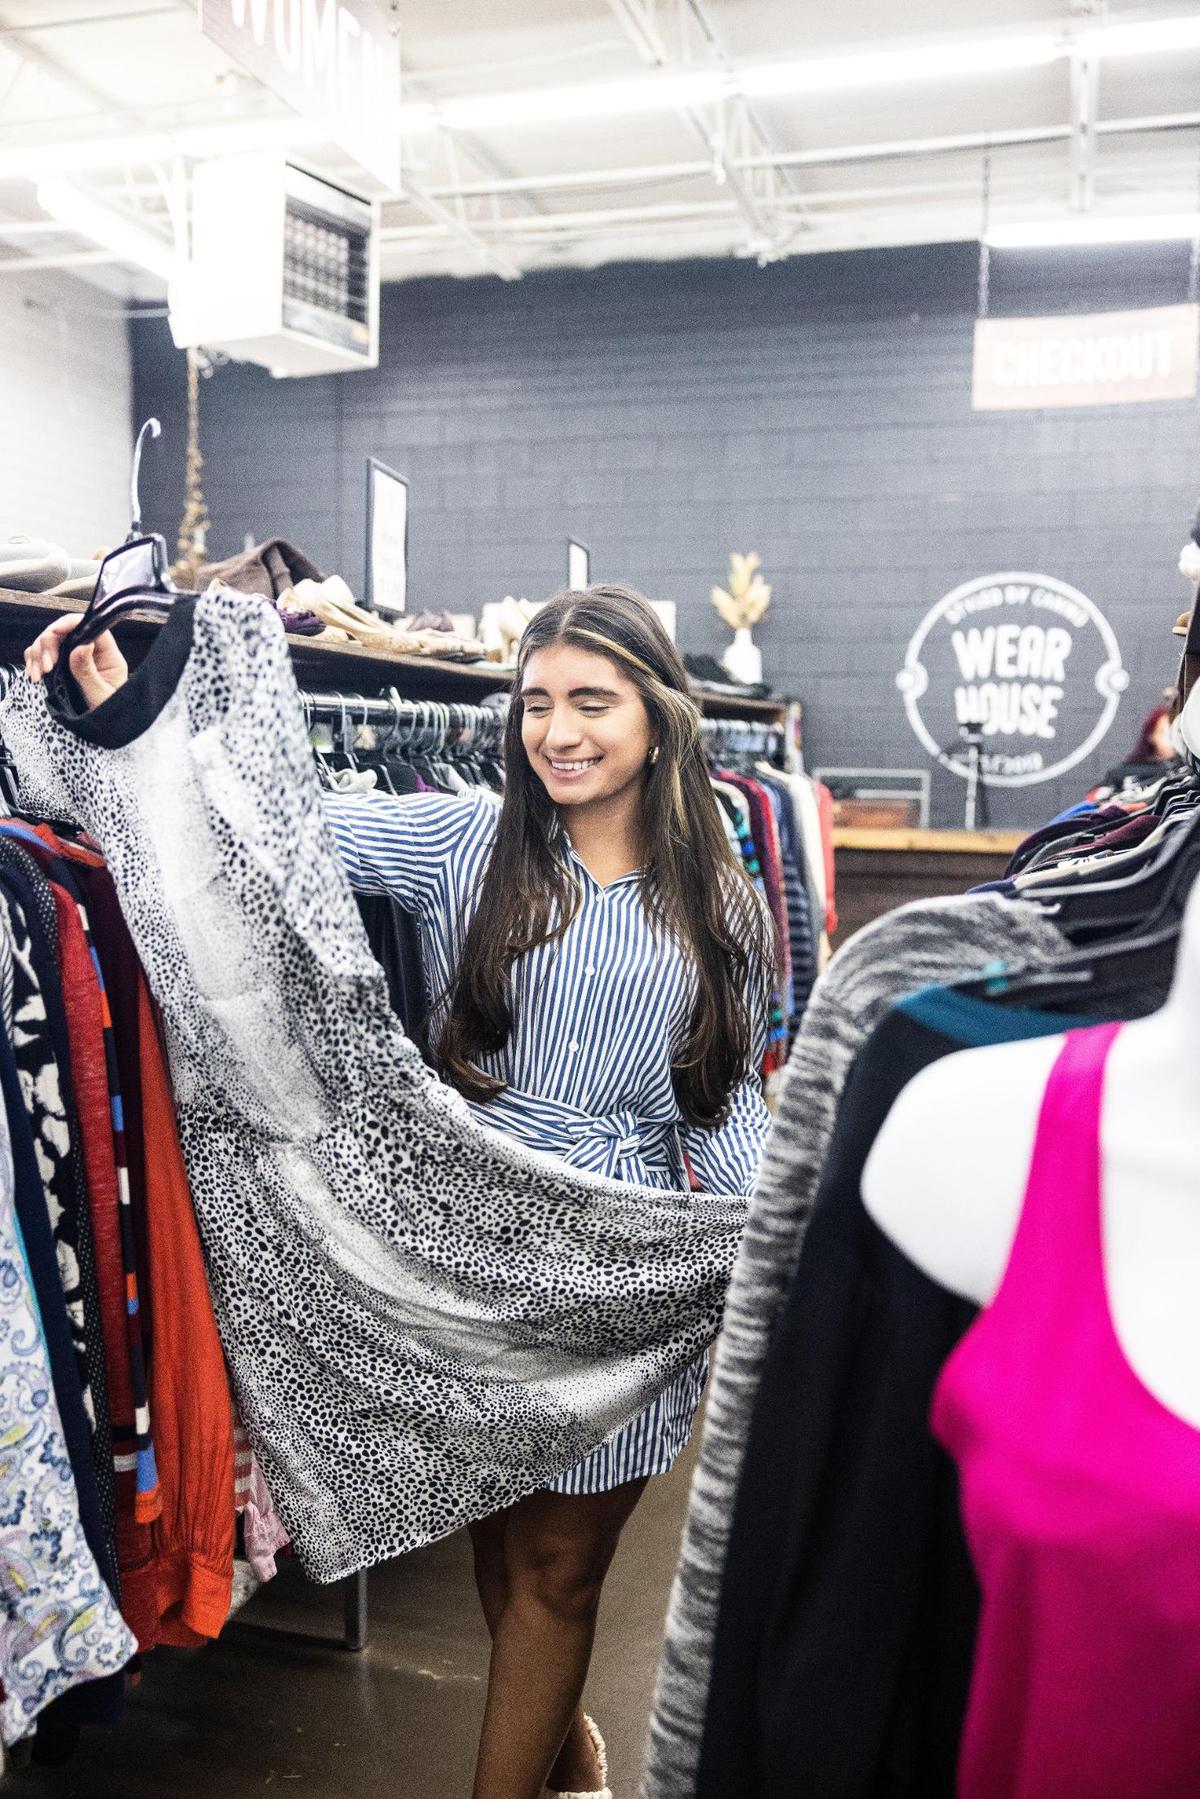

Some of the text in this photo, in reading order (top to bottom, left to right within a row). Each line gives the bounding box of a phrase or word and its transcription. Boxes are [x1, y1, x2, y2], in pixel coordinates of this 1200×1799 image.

[992, 329, 1176, 387] CHECKOUT
[951, 624, 1072, 682] WEAR
[954, 682, 1064, 739] HOUSE
